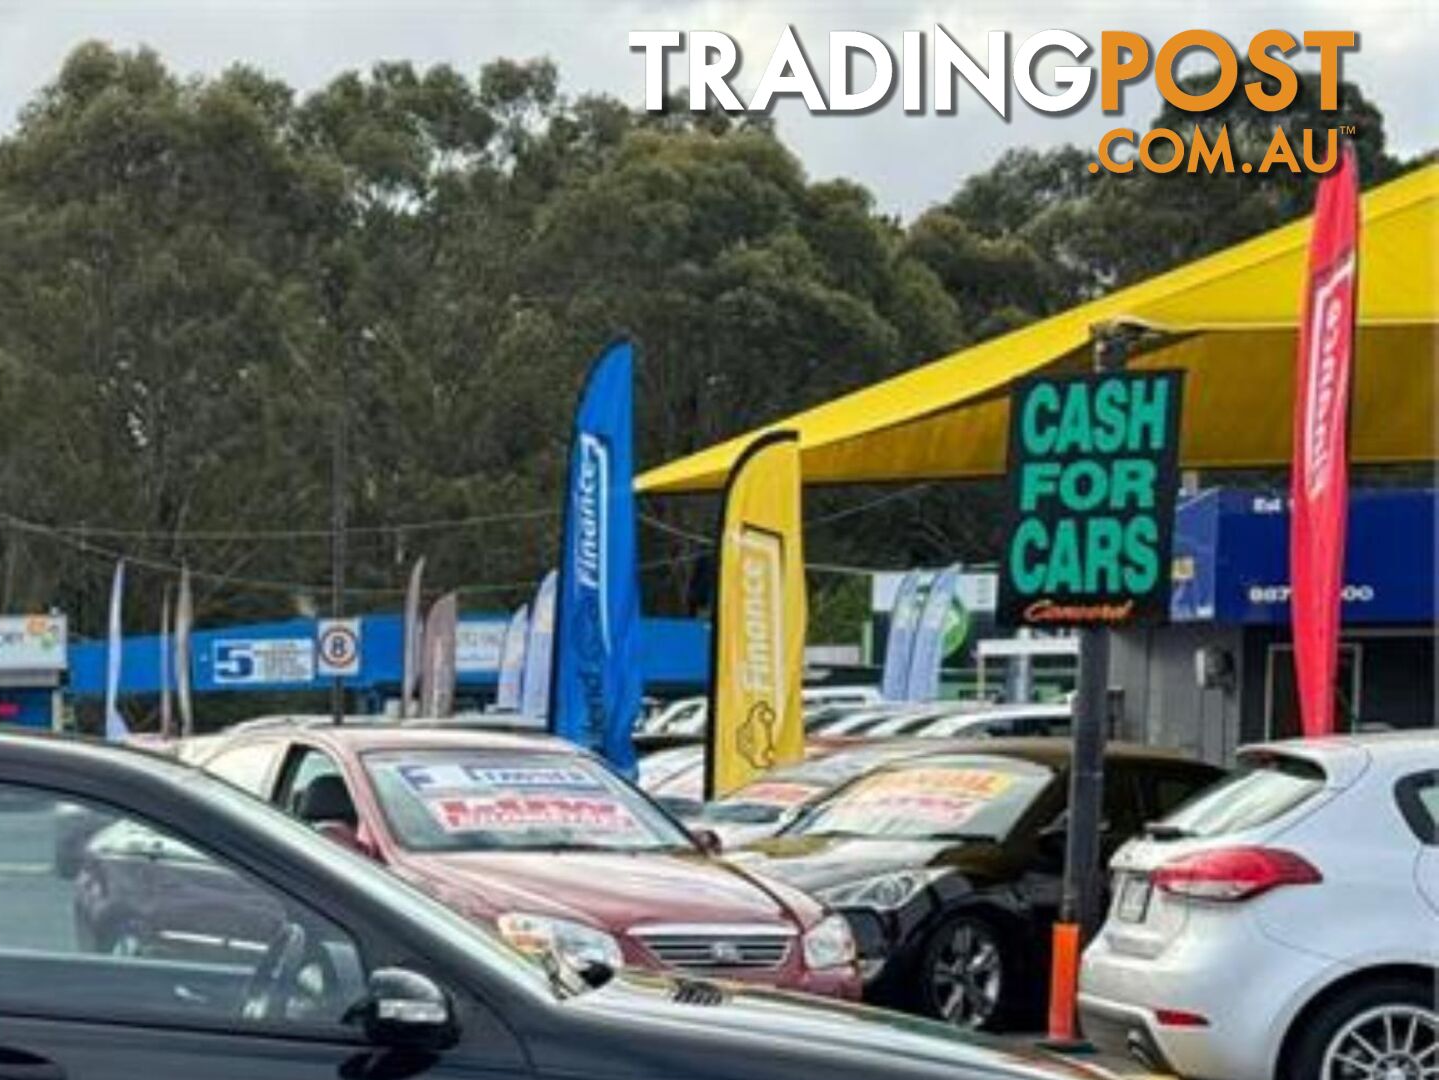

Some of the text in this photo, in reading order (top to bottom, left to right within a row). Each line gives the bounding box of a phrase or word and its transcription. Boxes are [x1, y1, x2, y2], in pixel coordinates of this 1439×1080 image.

[1022, 378, 1169, 455] CASH
[1020, 458, 1156, 512] FOR
[574, 461, 598, 590] Finance
[1011, 515, 1159, 595] CARS
[216, 645, 255, 678] 5
[332, 634, 345, 657] 8
